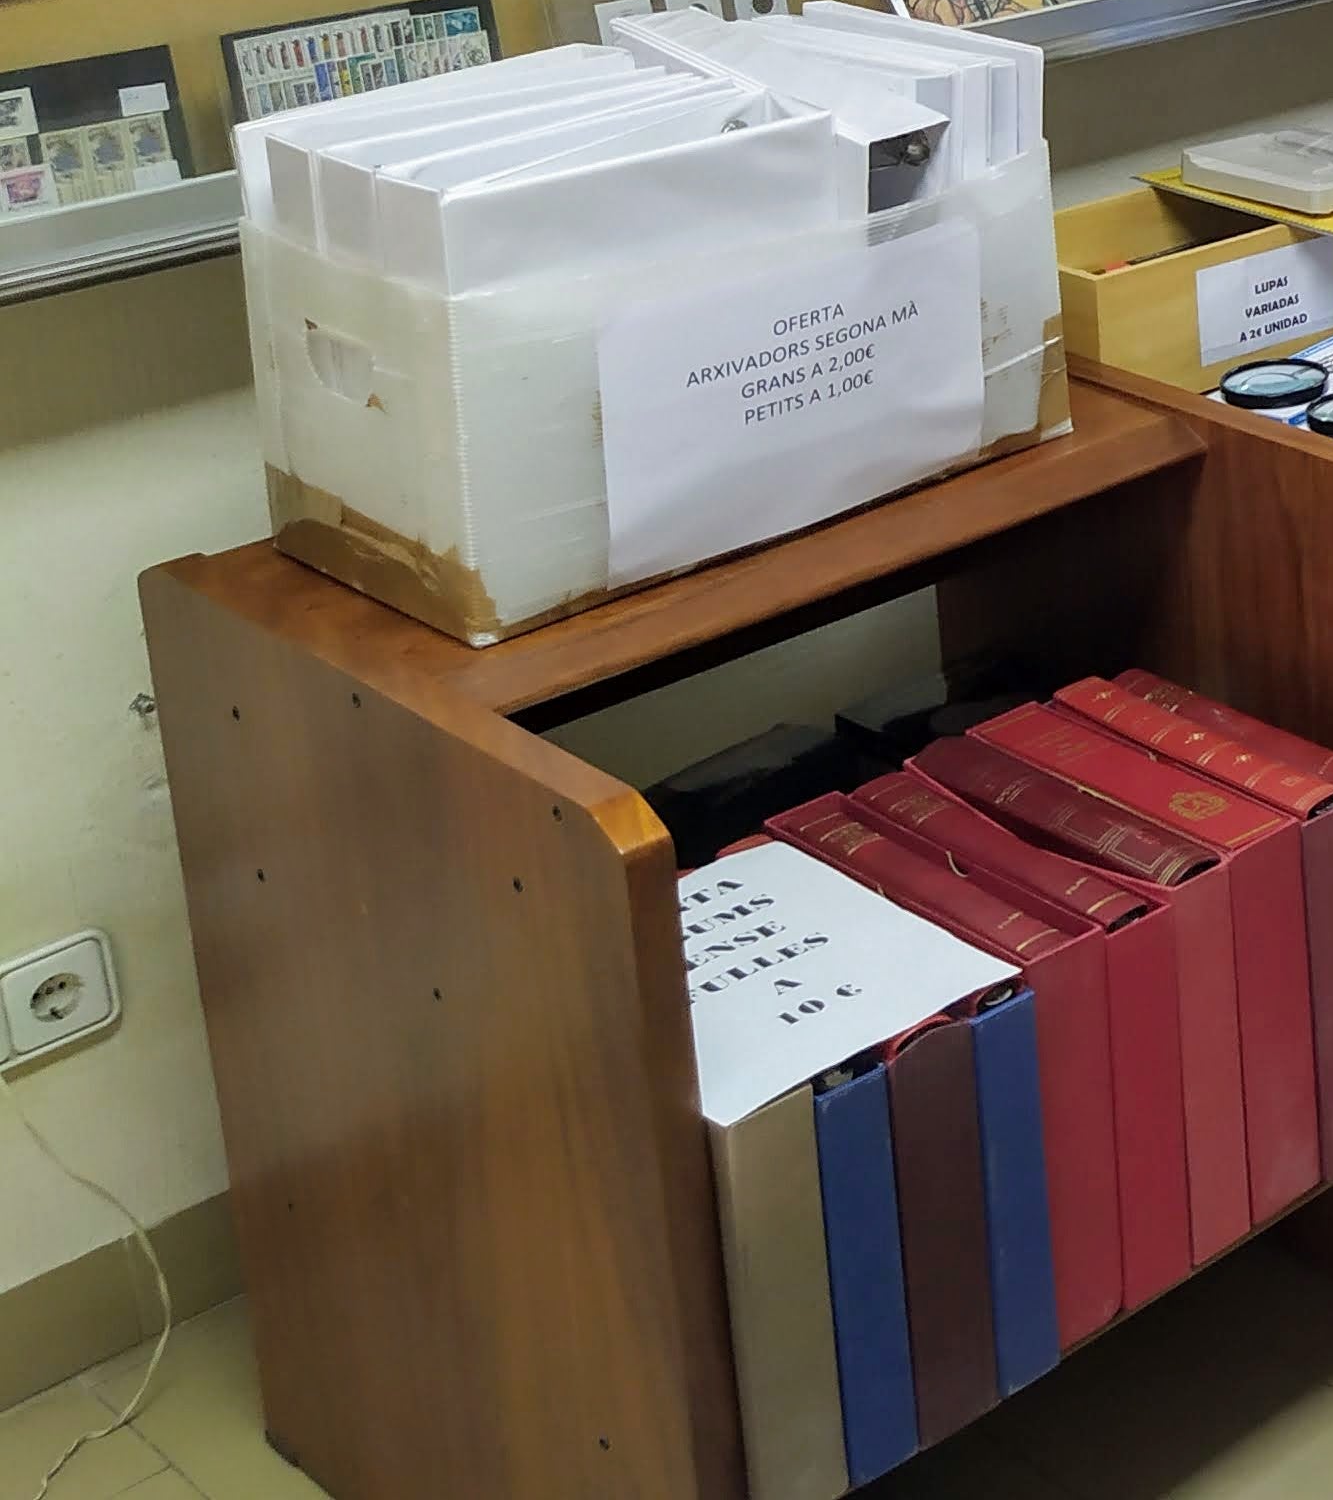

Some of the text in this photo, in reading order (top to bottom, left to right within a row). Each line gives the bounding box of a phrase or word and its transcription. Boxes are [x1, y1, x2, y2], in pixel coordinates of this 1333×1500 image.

[1254, 276, 1288, 295] LUPAS
[773, 303, 844, 336] OFERTA
[1245, 294, 1300, 318] VARIADAS
[1240, 313, 1308, 343] A 2€ UNIDAD
[686, 300, 919, 388] ARXIVADORS SEGONA MÀ
[741, 343, 876, 399] GRANS A 2,00€
[744, 369, 874, 425] PETITS A 1,00€
[774, 979, 803, 996] A
[836, 983, 863, 998] €
